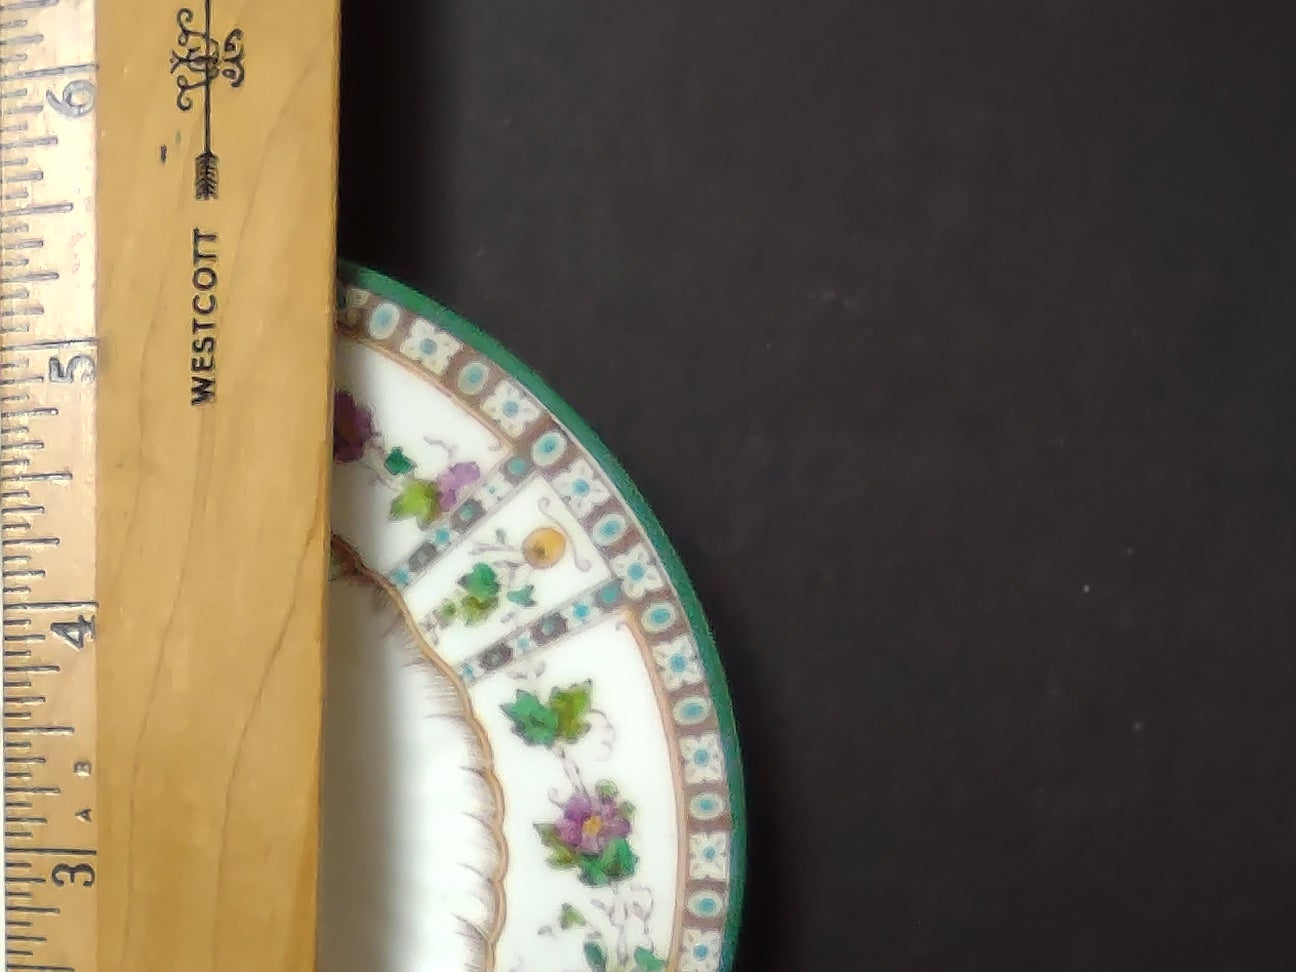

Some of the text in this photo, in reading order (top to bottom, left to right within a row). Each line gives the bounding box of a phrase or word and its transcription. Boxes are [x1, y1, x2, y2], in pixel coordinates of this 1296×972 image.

[46, 80, 95, 118] 6
[191, 228, 217, 405] WESTCOTT
[49, 354, 95, 384] 5
[51, 614, 96, 650] 4
[74, 760, 92, 822] A B
[51, 863, 95, 887] 3
